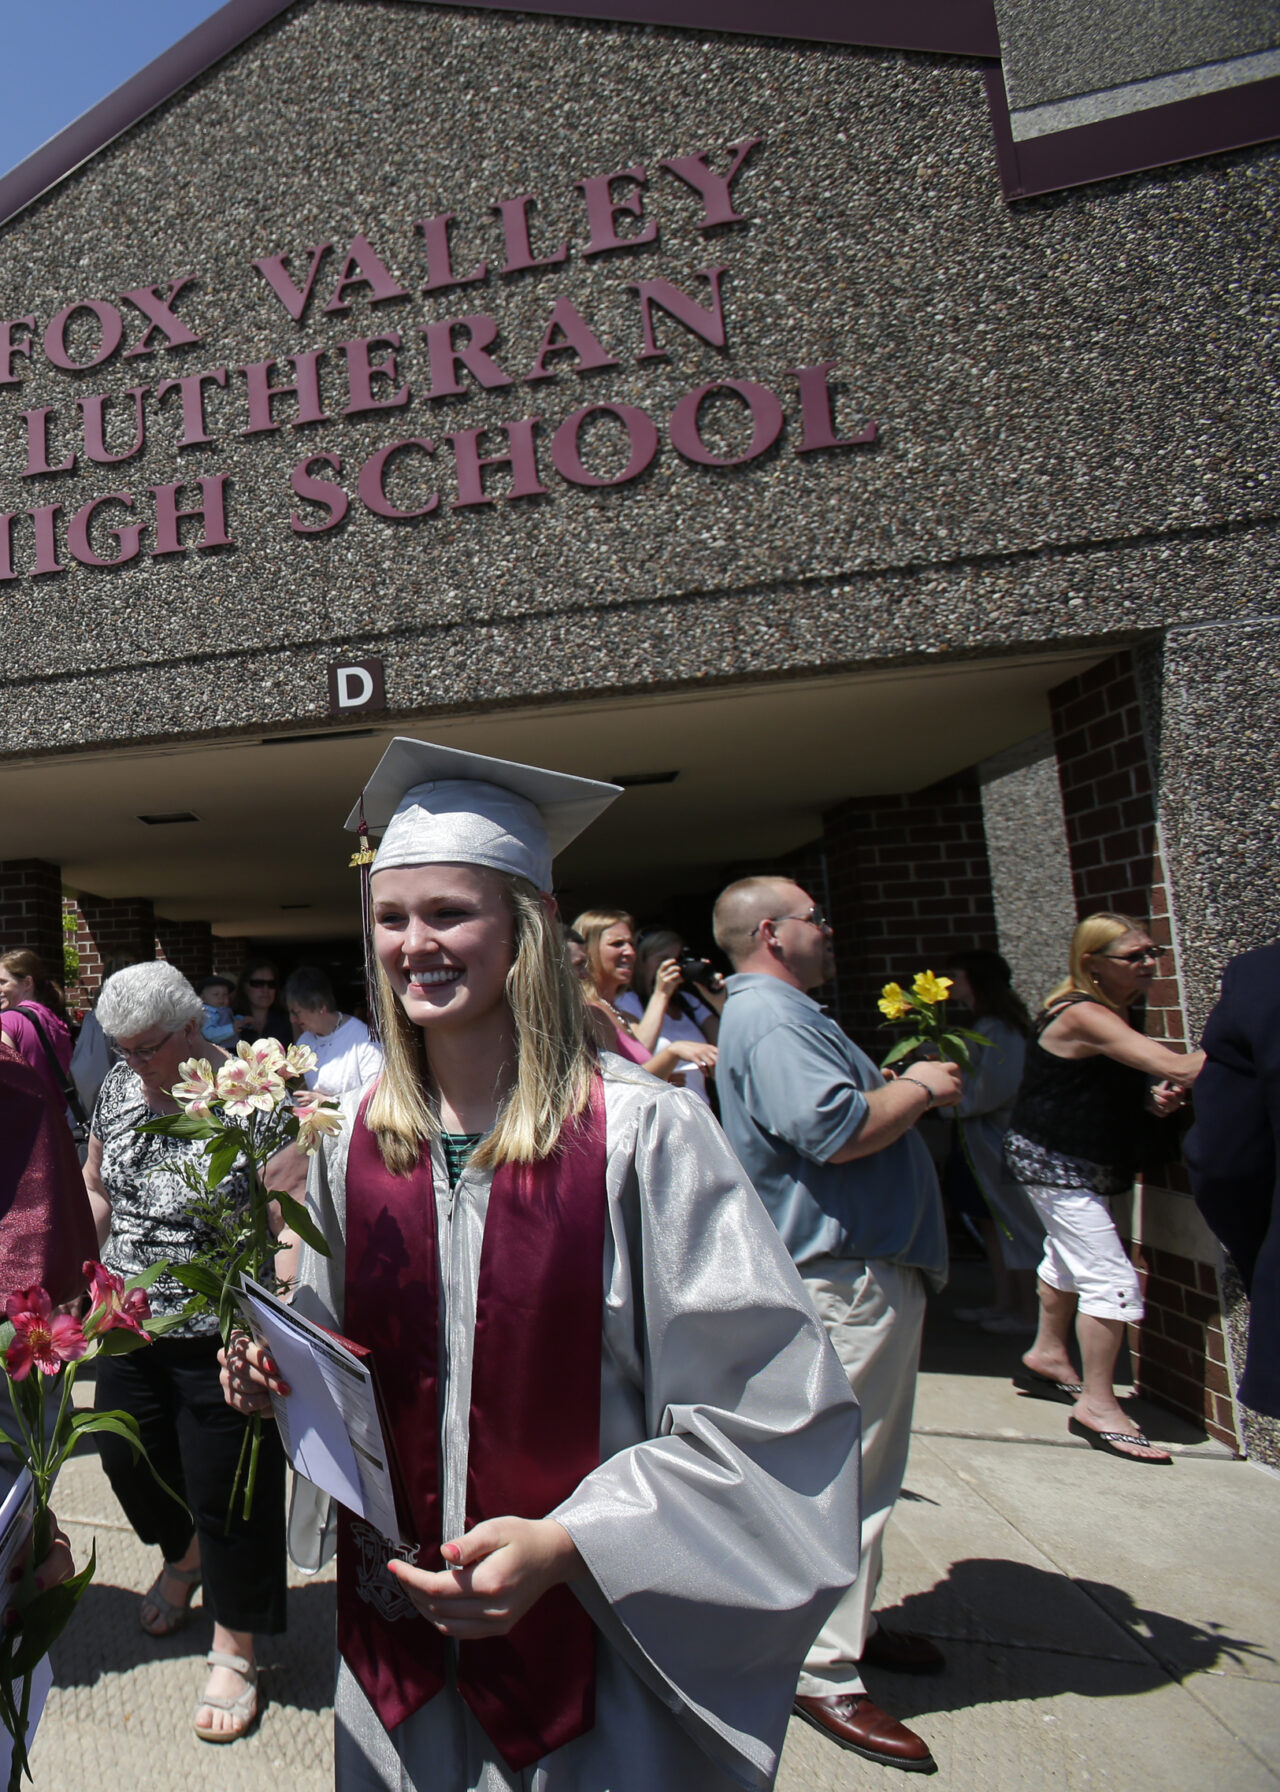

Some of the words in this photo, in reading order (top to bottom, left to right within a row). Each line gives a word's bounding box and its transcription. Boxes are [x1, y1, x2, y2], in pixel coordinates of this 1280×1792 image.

[251, 136, 763, 320] VALLEY
[20, 264, 728, 477] LUTHERAN
[291, 360, 877, 533] SCHOOL
[336, 665, 374, 708] D
